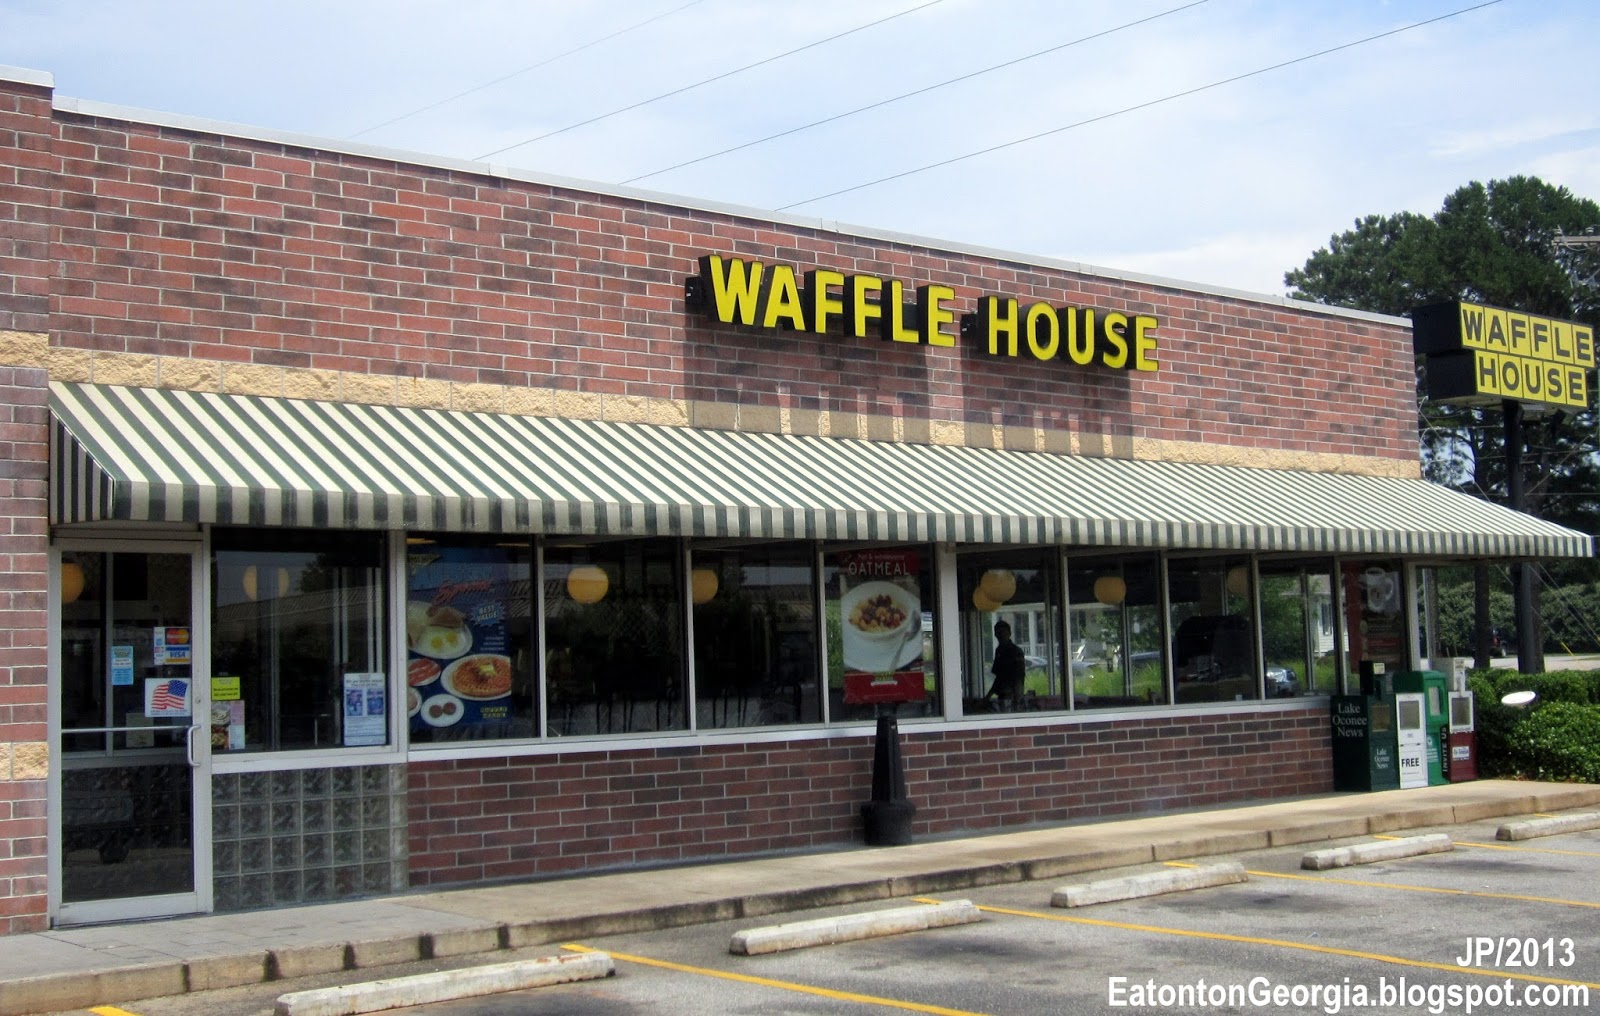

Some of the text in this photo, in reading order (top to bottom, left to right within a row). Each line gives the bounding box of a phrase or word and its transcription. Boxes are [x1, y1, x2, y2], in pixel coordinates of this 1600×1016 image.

[709, 255, 1158, 371] WAFFLE HOUSE
[1462, 309, 1591, 361] WAFFLE
[1479, 356, 1584, 400] HOUSE
[848, 561, 909, 576] OATMEAL
[1338, 702, 1361, 714] Lake
[1332, 715, 1368, 725] Oconee
[1337, 727, 1364, 738] News
[1401, 757, 1420, 768] FREE
